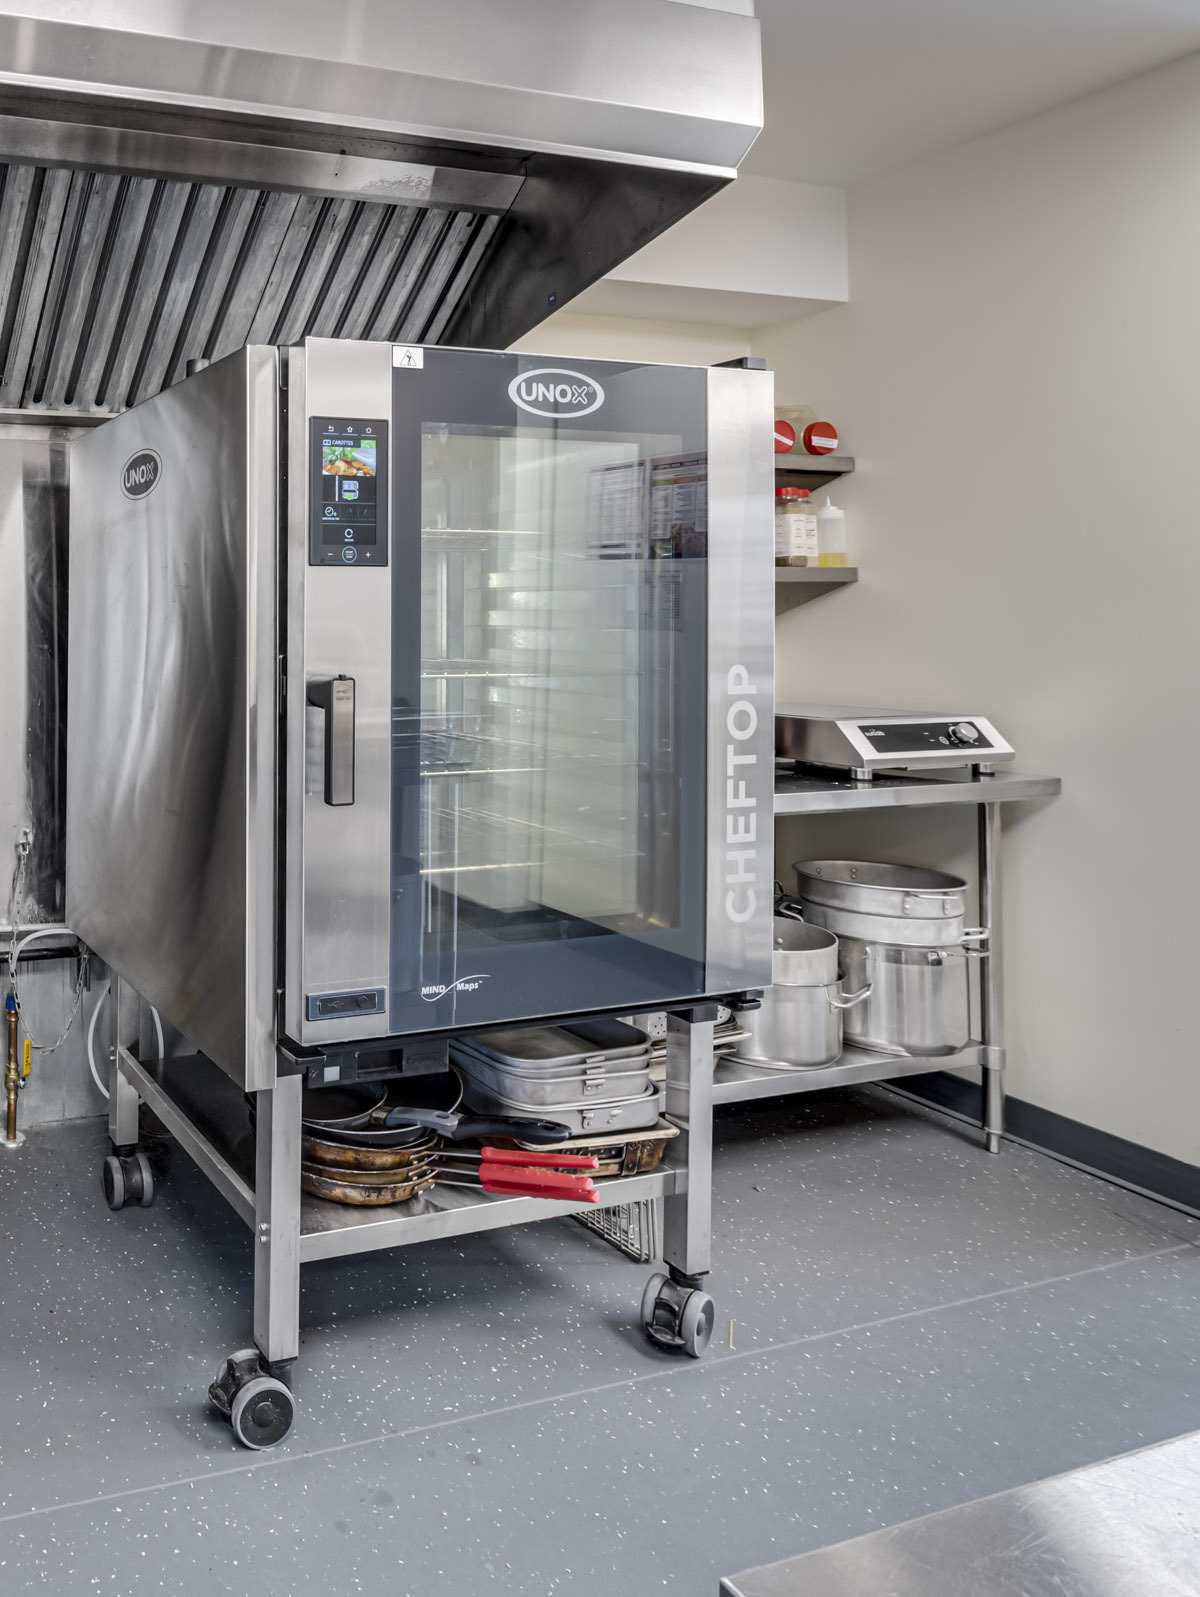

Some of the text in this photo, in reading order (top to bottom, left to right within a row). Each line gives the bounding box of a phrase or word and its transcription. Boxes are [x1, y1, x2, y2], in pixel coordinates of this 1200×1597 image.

[124, 460, 155, 489] UNOX
[725, 663, 758, 924] CHEFTOP
[421, 984, 446, 995] MIND
